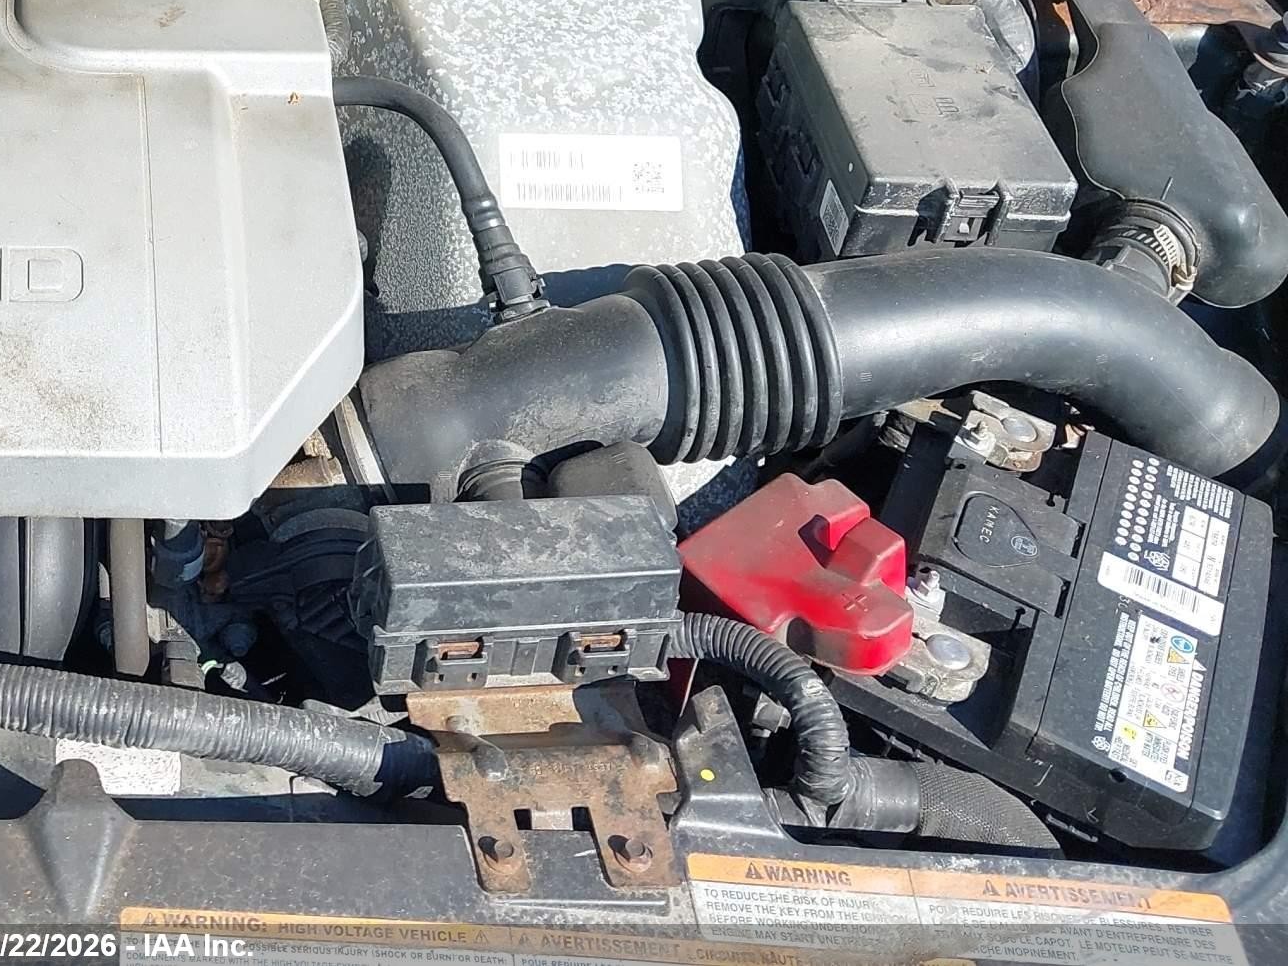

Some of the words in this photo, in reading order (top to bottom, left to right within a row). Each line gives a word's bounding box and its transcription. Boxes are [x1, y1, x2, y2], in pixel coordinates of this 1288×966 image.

[1177, 671, 1204, 760] DANGER/POISON
[764, 865, 852, 885] WARNING
[704, 888, 718, 899] TO
[722, 890, 768, 901] REDUCE
[769, 893, 790, 903] THE
[793, 895, 817, 905] RISK
[822, 898, 835, 907] OF
[706, 901, 752, 913] REMOVE
[756, 905, 776, 915] THE
[780, 907, 799, 917] KEY
[804, 909, 835, 920] FROM
[838, 911, 858, 921] THE
[163, 913, 266, 932] WARNING:
[278, 921, 317, 935] HIGH
[323, 924, 394, 940] VOLTAGE
[399, 928, 466, 943] VEHICLE
[755, 930, 776, 939] MAY
[1168, 925, 1213, 937] RETIRER
[541, 935, 680, 956] AVERTISSEMENT
[1096, 929, 1192, 947] D'ENTREPRENDRE
[1194, 939, 1216, 950] DES
[291, 945, 331, 955] SERIOUS
[334, 946, 369, 956] INJURY
[372, 948, 406, 958] (SHOCK
[411, 950, 423, 960] OR
[458, 953, 470, 962] OR
[1021, 936, 1033, 945] LE
[1035, 936, 1074, 948] CAPOT.
[1079, 940, 1094, 950] LE
[1095, 941, 1142, 954] MOTEUR
[1143, 946, 1169, 957] PEUT
[1174, 950, 1188, 960] SE
[1190, 951, 1234, 965] METTRE
